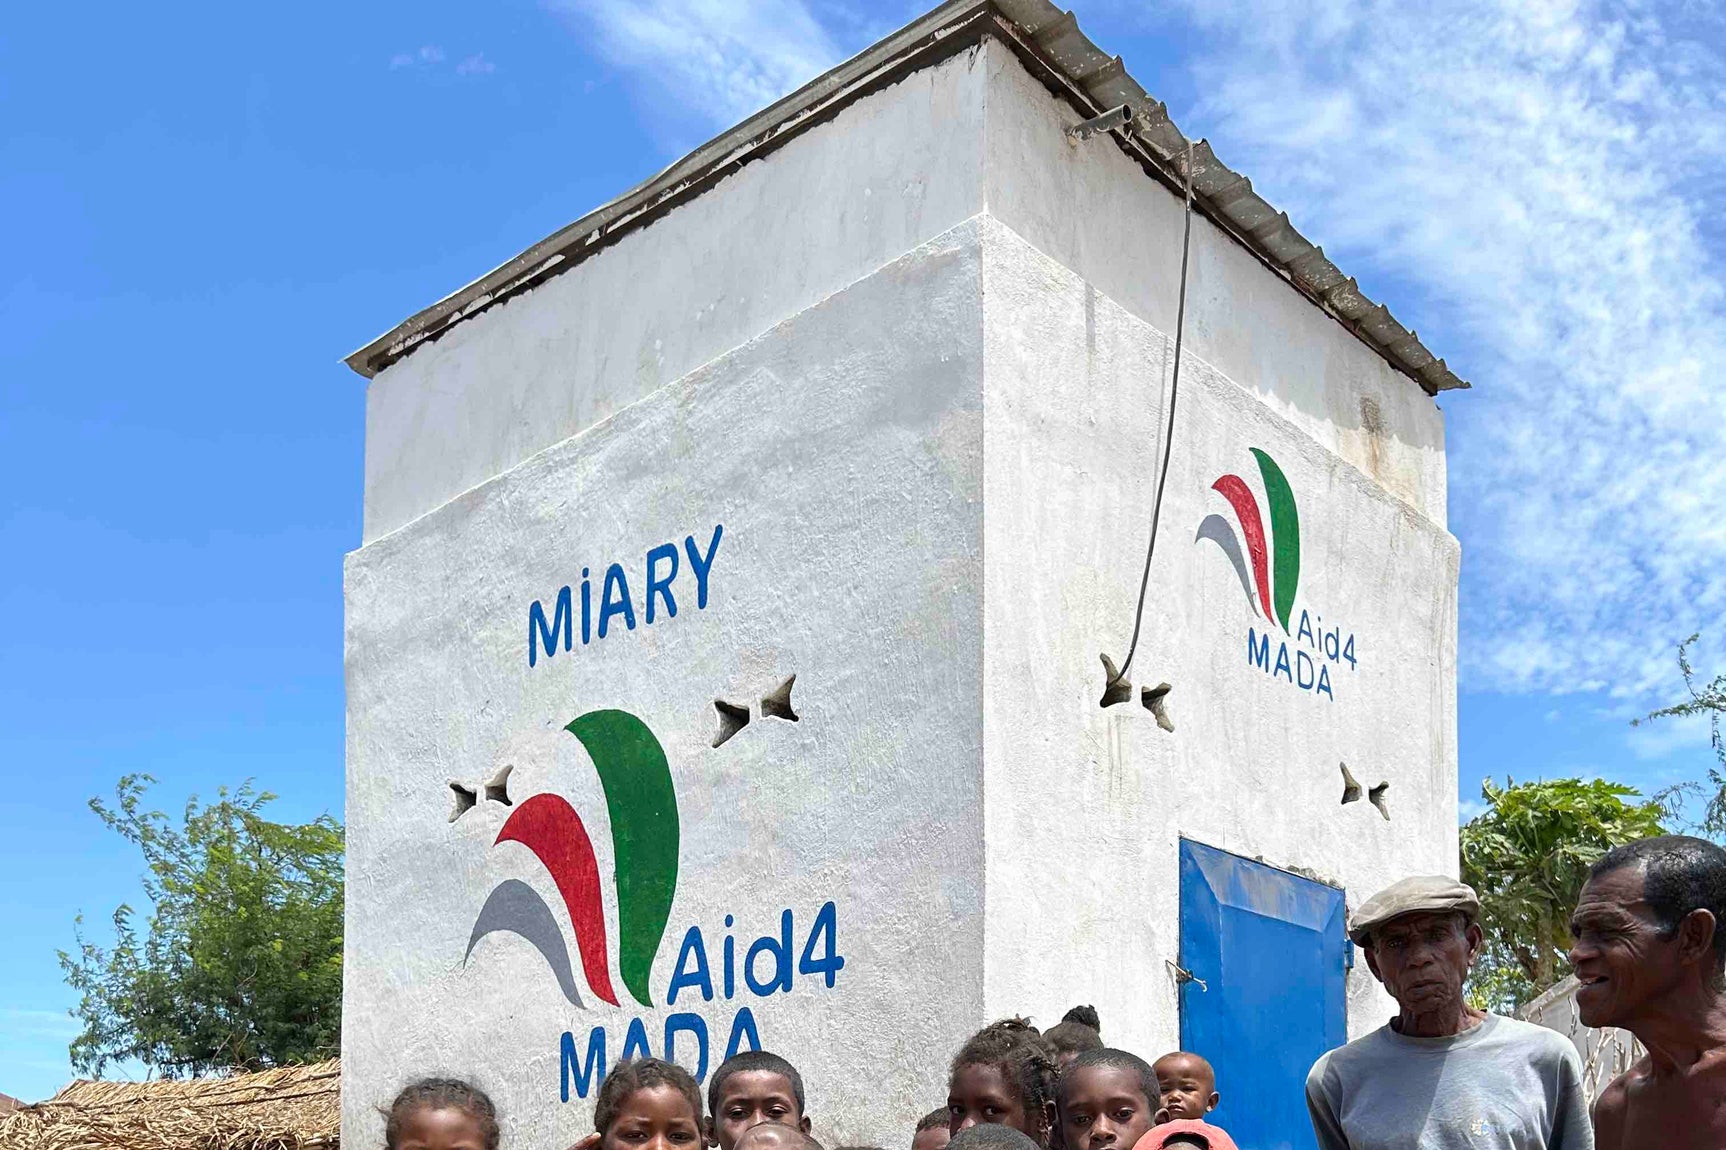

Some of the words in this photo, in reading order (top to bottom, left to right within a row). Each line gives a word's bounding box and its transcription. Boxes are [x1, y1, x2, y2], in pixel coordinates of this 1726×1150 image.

[1248, 627, 1333, 701] MADA
[1298, 609, 1357, 671] Aid4
[667, 902, 845, 1006] Aid4
